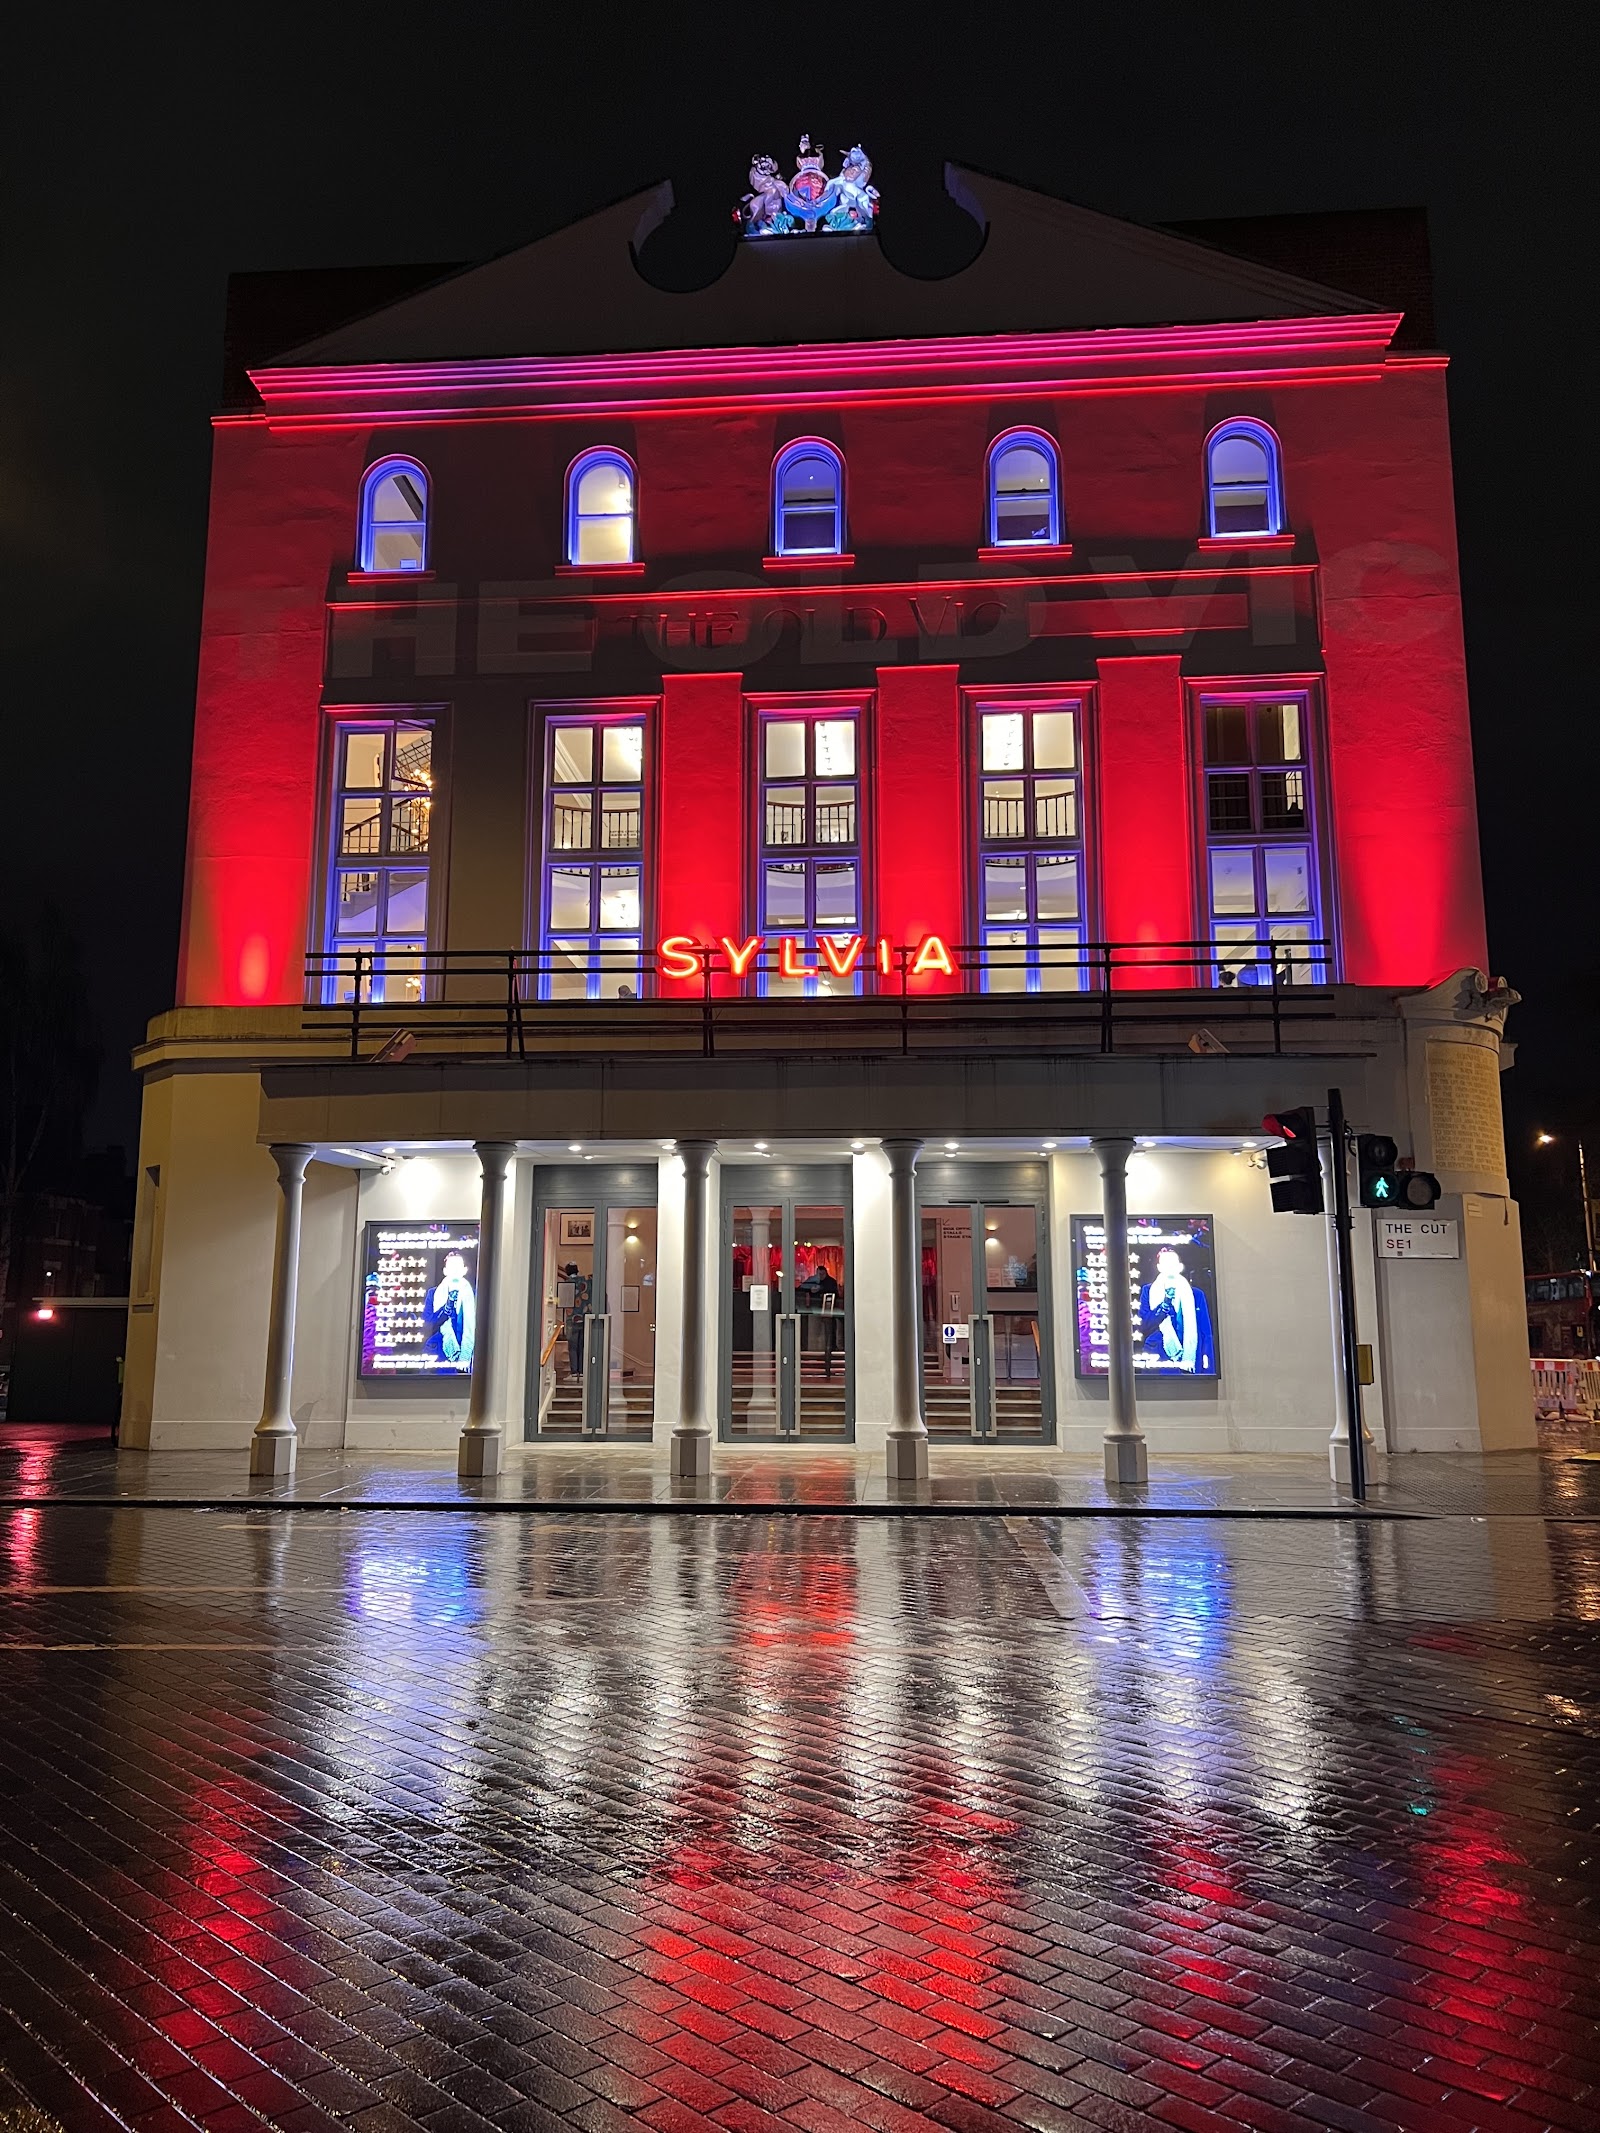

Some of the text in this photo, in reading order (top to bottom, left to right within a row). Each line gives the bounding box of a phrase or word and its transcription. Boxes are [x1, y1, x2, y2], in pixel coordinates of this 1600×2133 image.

[204, 540, 1452, 681] THE OLD VIC
[616, 610, 741, 650] THE
[761, 605, 888, 645] OLD
[656, 934, 960, 979] SYLVIA
[1385, 1223, 1448, 1234] THE CUT
[1386, 1239, 1412, 1249] SE1
